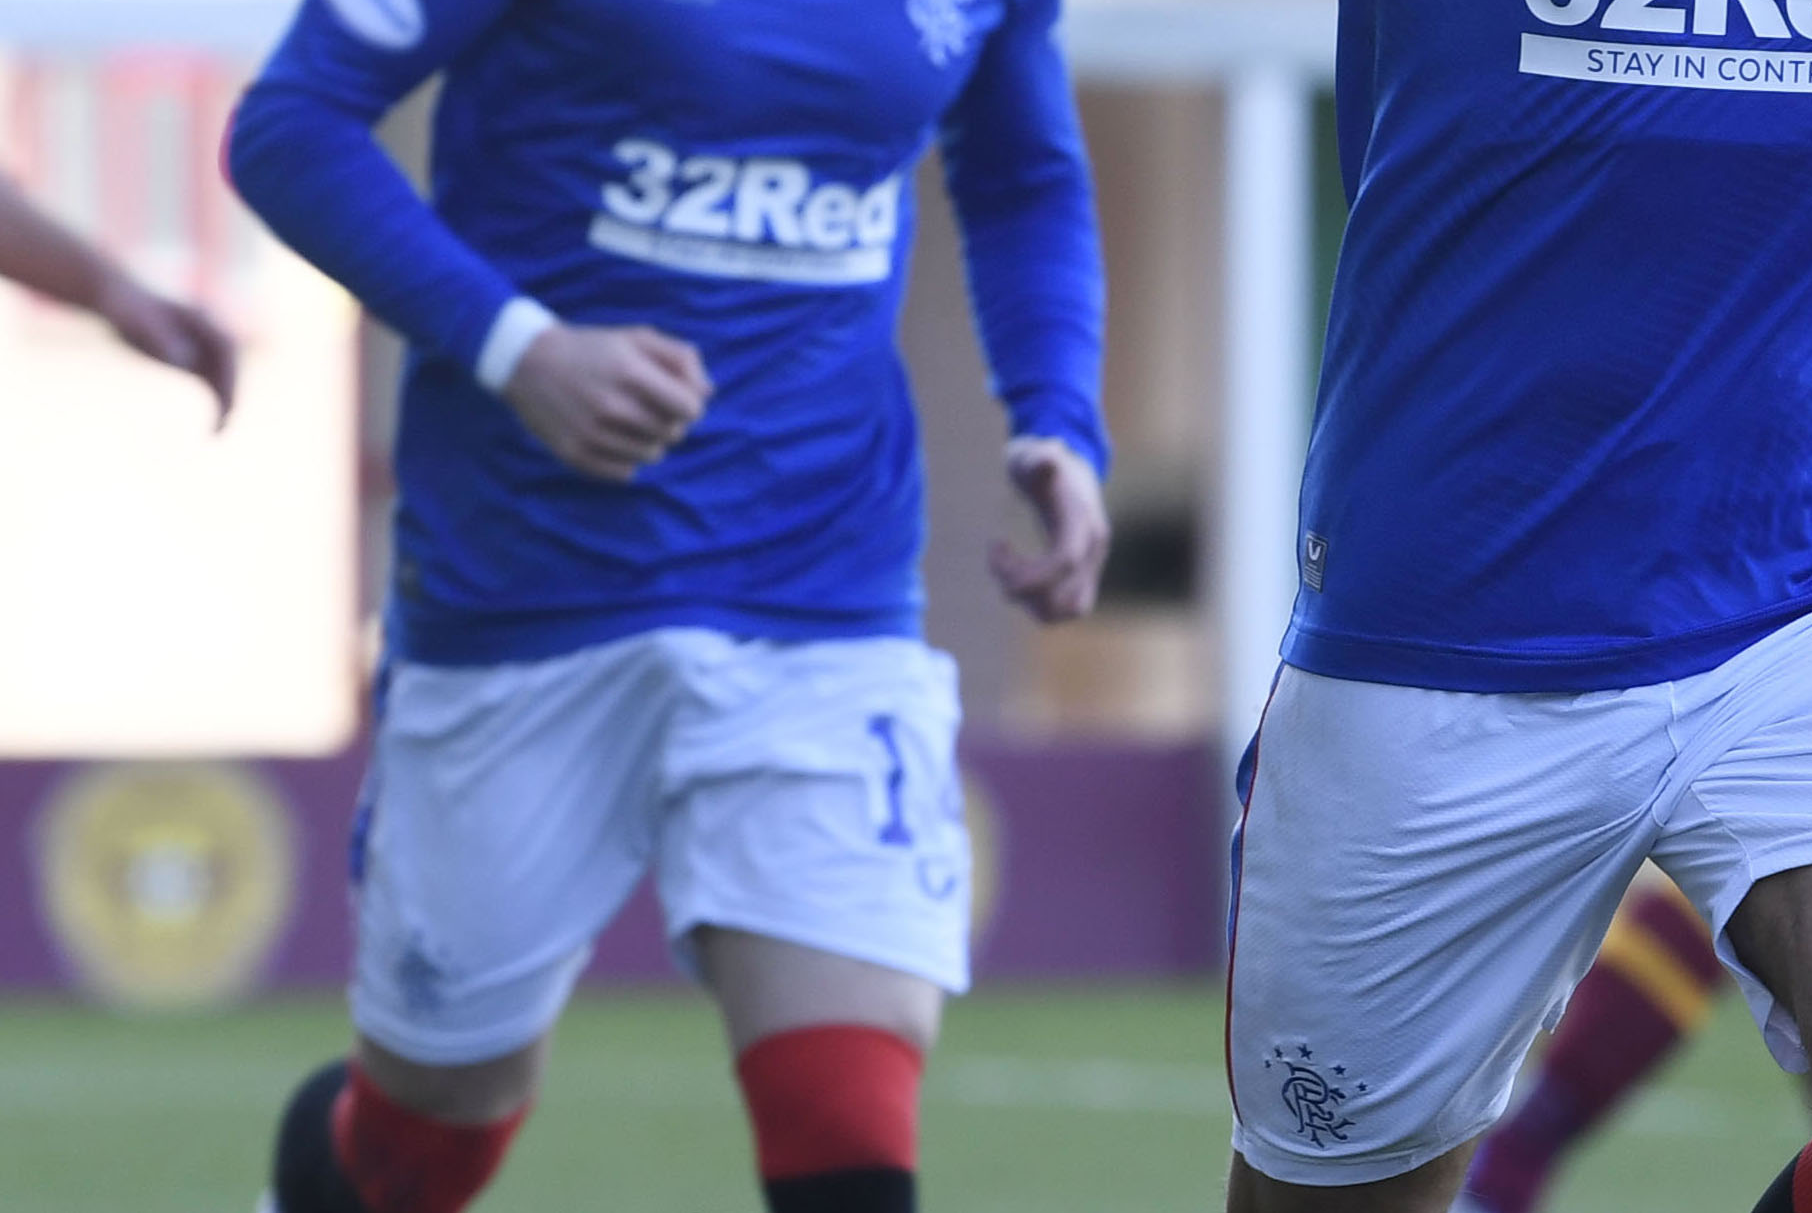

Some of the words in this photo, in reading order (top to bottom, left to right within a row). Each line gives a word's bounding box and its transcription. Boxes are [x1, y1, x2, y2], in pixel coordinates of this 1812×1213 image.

[1586, 48, 1665, 77] STAY
[1673, 55, 1706, 79] IN
[601, 137, 902, 252] 32Red
